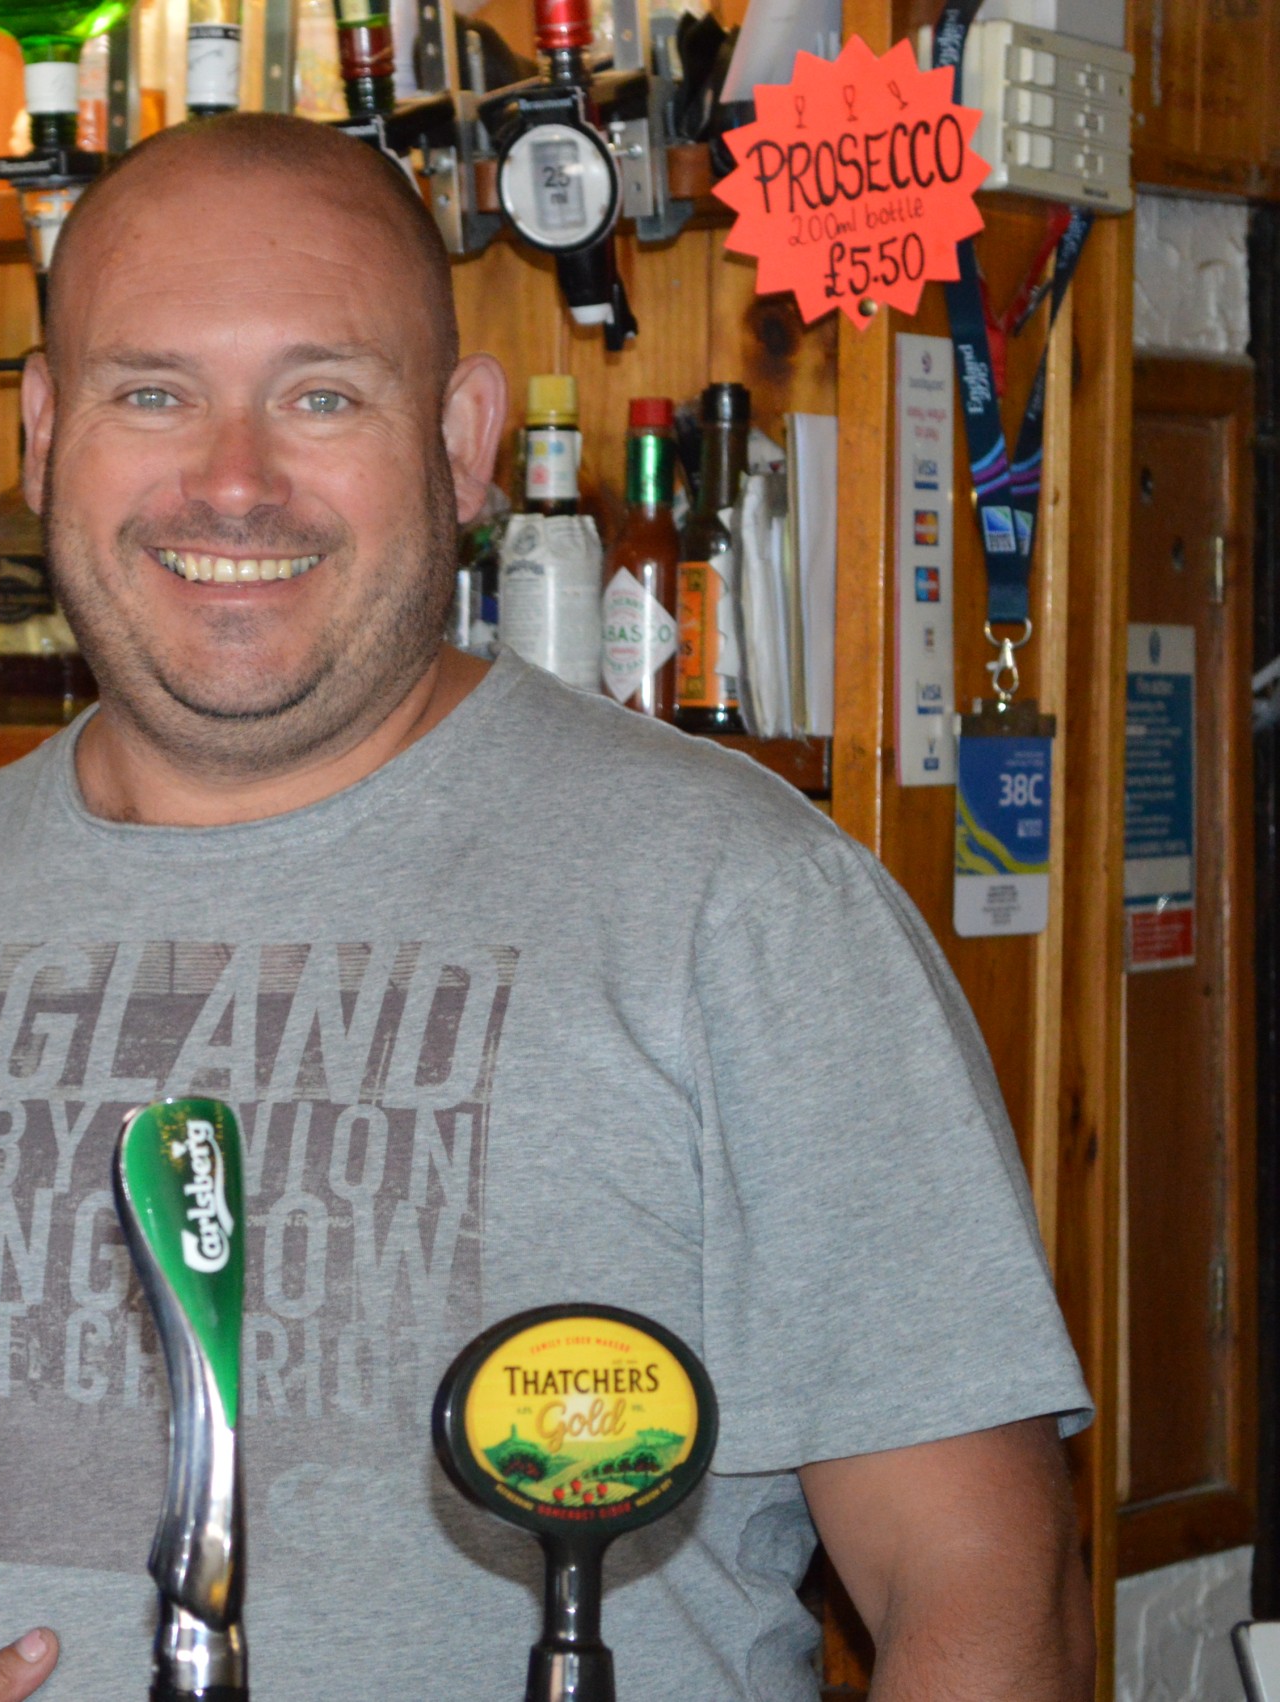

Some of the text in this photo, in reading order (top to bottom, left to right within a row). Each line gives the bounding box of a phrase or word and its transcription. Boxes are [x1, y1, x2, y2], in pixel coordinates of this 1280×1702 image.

[745, 113, 964, 213] PROSECCO
[787, 197, 924, 247] 200ml bottle
[824, 232, 925, 298] £5.50
[998, 773, 1045, 807] 38C
[172, 1119, 234, 1273] Carlsberg
[503, 1363, 660, 1397] THATCHERS
[535, 1397, 628, 1454] Gold
